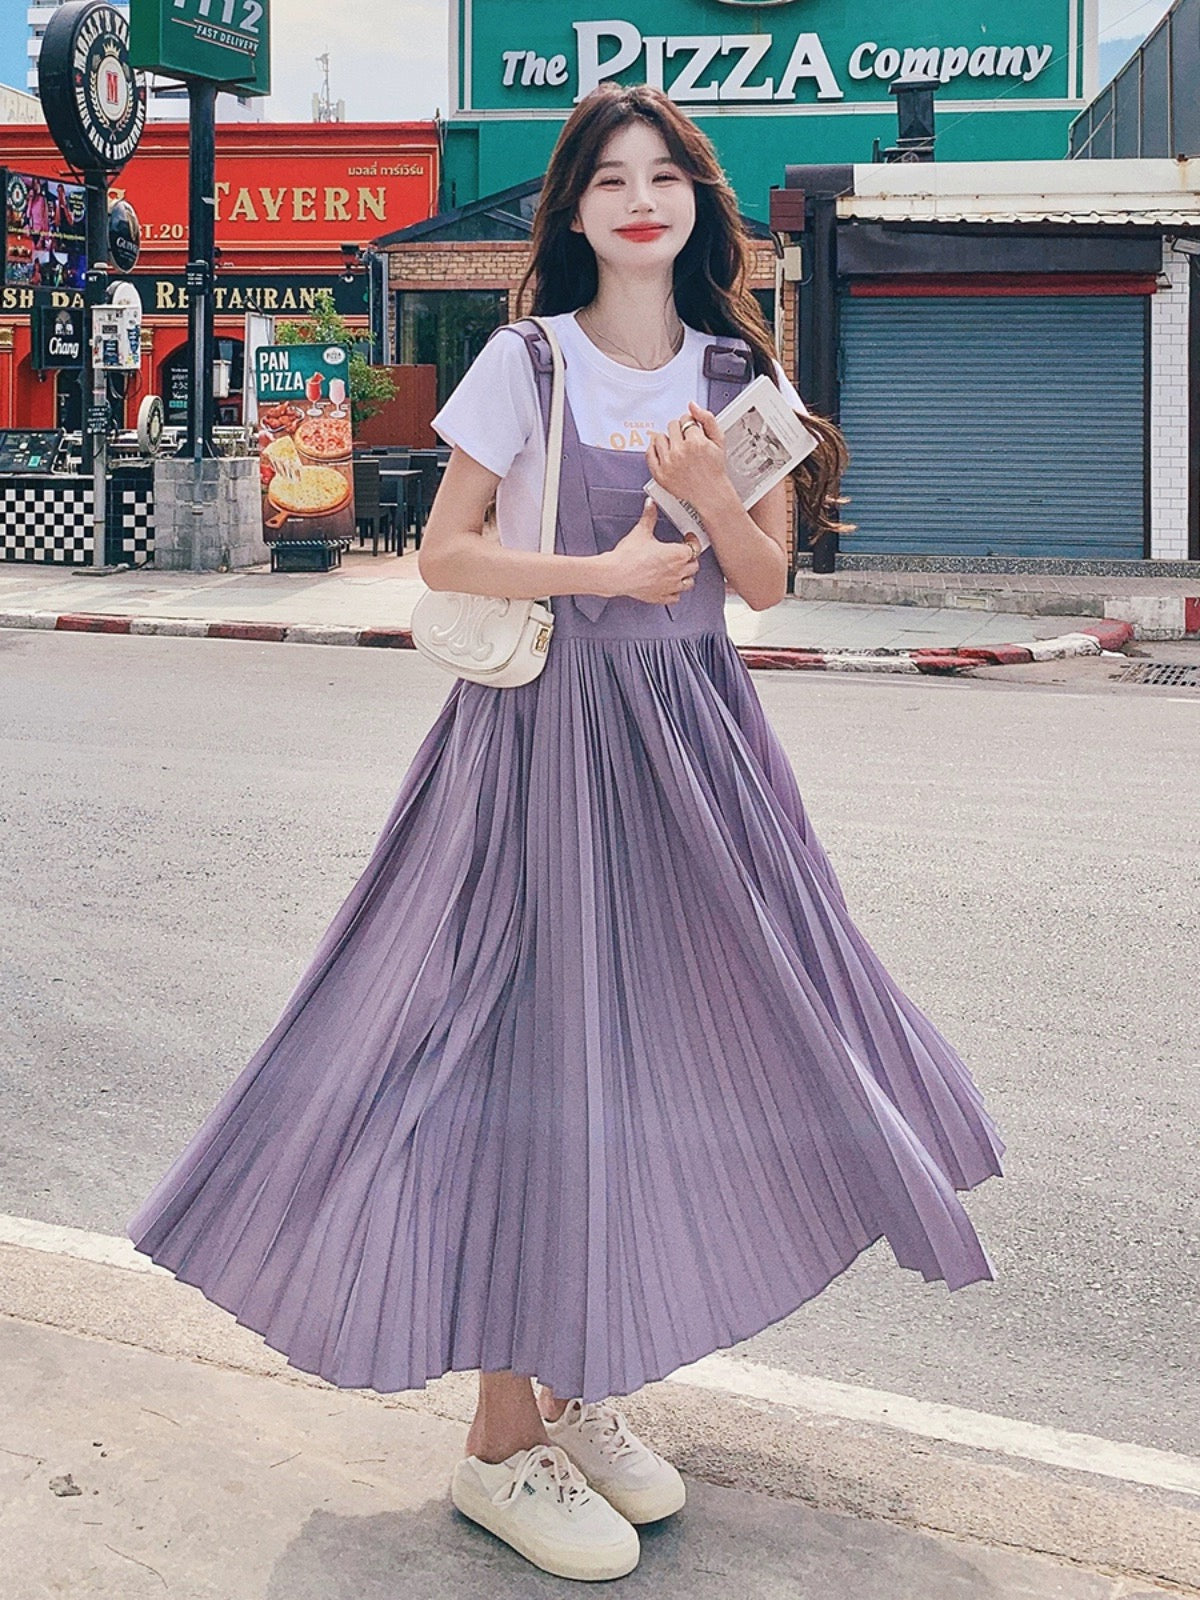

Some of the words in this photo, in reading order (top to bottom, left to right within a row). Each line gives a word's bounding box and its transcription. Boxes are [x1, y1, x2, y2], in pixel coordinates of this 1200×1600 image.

[197, 25, 218, 42] FAST
[219, 32, 260, 52] DELIVERY
[502, 50, 569, 86] The
[572, 19, 844, 103] PIZZA
[849, 42, 1053, 83] Company
[214, 182, 387, 221] TAVERN
[155, 281, 333, 309] RETAURANT
[49, 337, 80, 358] Chang
[260, 351, 289, 371] PAN
[261, 371, 305, 392] PIZZA
